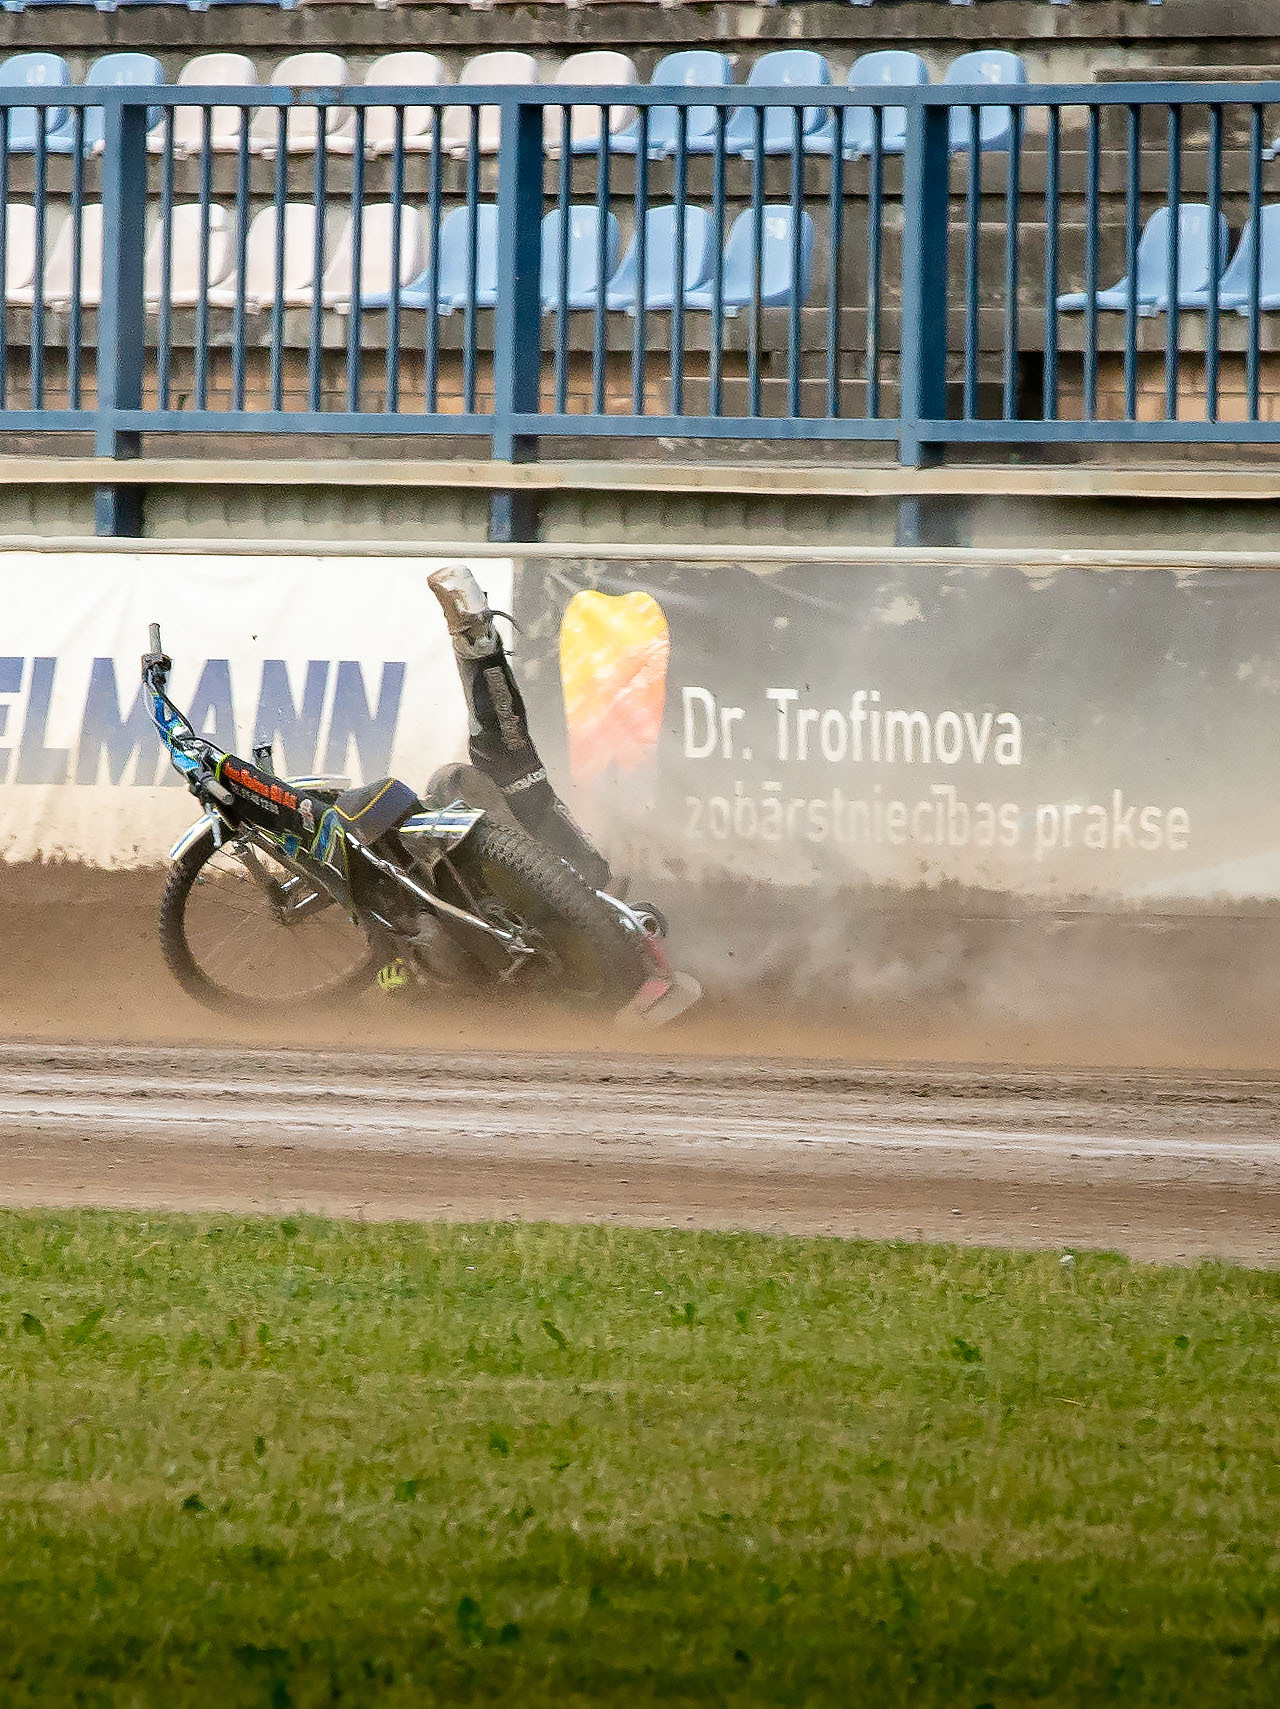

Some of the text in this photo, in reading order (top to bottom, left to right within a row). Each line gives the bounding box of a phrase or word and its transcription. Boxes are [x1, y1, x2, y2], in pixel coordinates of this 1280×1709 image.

[682, 686, 1022, 766] Dr. Trofimova
[684, 780, 1192, 862] zobārstniecības prakse
